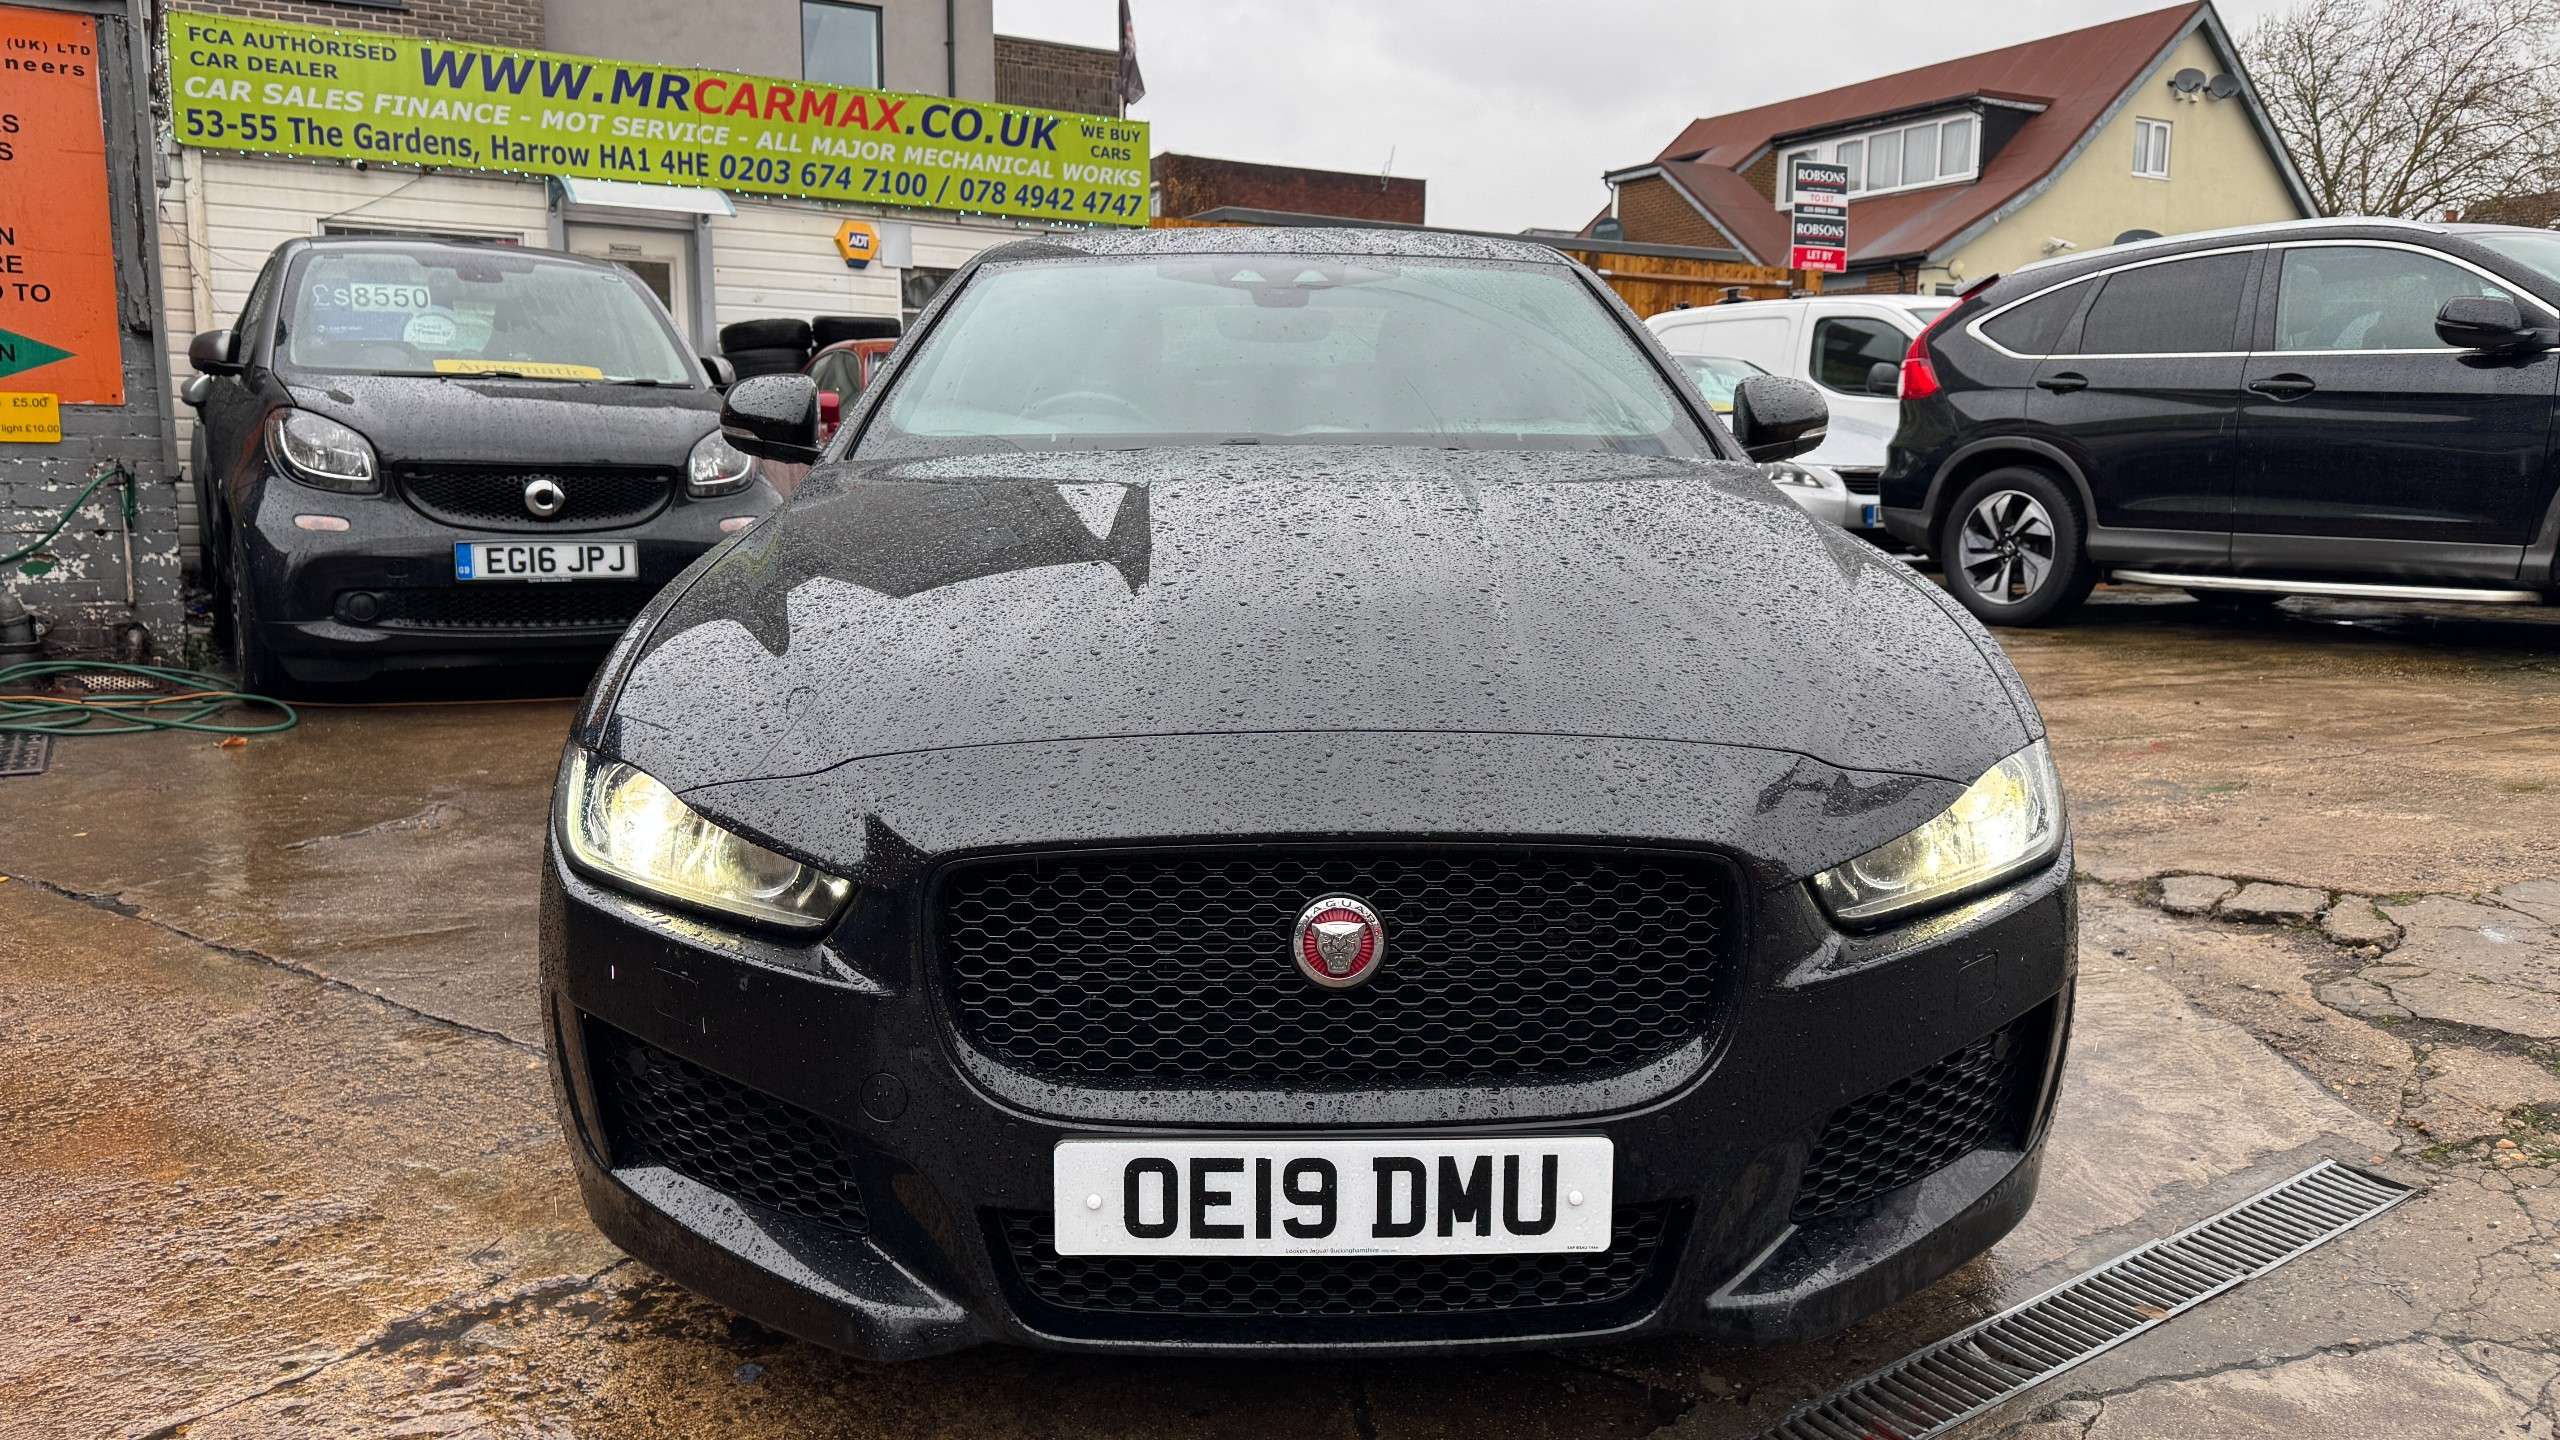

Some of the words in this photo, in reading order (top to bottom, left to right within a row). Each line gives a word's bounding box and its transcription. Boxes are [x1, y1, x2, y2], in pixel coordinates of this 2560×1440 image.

[7, 38, 48, 54] (UK)
[57, 43, 91, 56] LTD
[188, 26, 234, 45] FCA
[243, 32, 397, 62] AUTHORISED
[190, 51, 239, 70] CAR
[247, 56, 339, 79] DEALER
[420, 48, 1061, 151] WWW.MRCARMAX.CO.UK
[184, 76, 252, 103] CAR
[262, 83, 364, 112] SALES
[374, 93, 511, 126] FINANCE
[541, 109, 604, 134] MOT
[612, 115, 729, 146] SERVICE
[756, 131, 802, 152] ALL
[811, 136, 896, 162] MAJOR
[903, 146, 1054, 179] MECHANICAL
[1062, 163, 1142, 187] WORKS
[1081, 124, 1105, 140] WE
[1110, 128, 1141, 143] BUY
[186, 108, 278, 142] 53-55
[287, 117, 344, 147] The
[353, 122, 480, 164] Gardens,
[491, 134, 590, 167] Harrow
[599, 144, 651, 172] HA1
[660, 151, 710, 177] 4HE
[719, 154, 791, 184] 0203
[800, 162, 852, 190] 674
[861, 168, 928, 198] 7100
[960, 178, 1007, 205] 078
[1014, 183, 1075, 212] 4942
[1083, 191, 1142, 217] 4747
[1090, 145, 1131, 161] CARS
[1798, 168, 1845, 184] ROBSONS
[1796, 222, 1844, 237] ROBSONS
[849, 233, 868, 248] ADT
[1806, 249, 1821, 260] LET
[12, 282, 51, 303] TO
[12, 396, 48, 408] £5.00
[1, 423, 23, 435] light
[25, 424, 60, 434] £10.00
[486, 546, 557, 574] EG16
[567, 546, 626, 573] JPJ
[1304, 898, 1377, 924] JAGUAR
[1122, 1157, 1338, 1240] OE19
[1371, 1154, 1560, 1238] DMU
